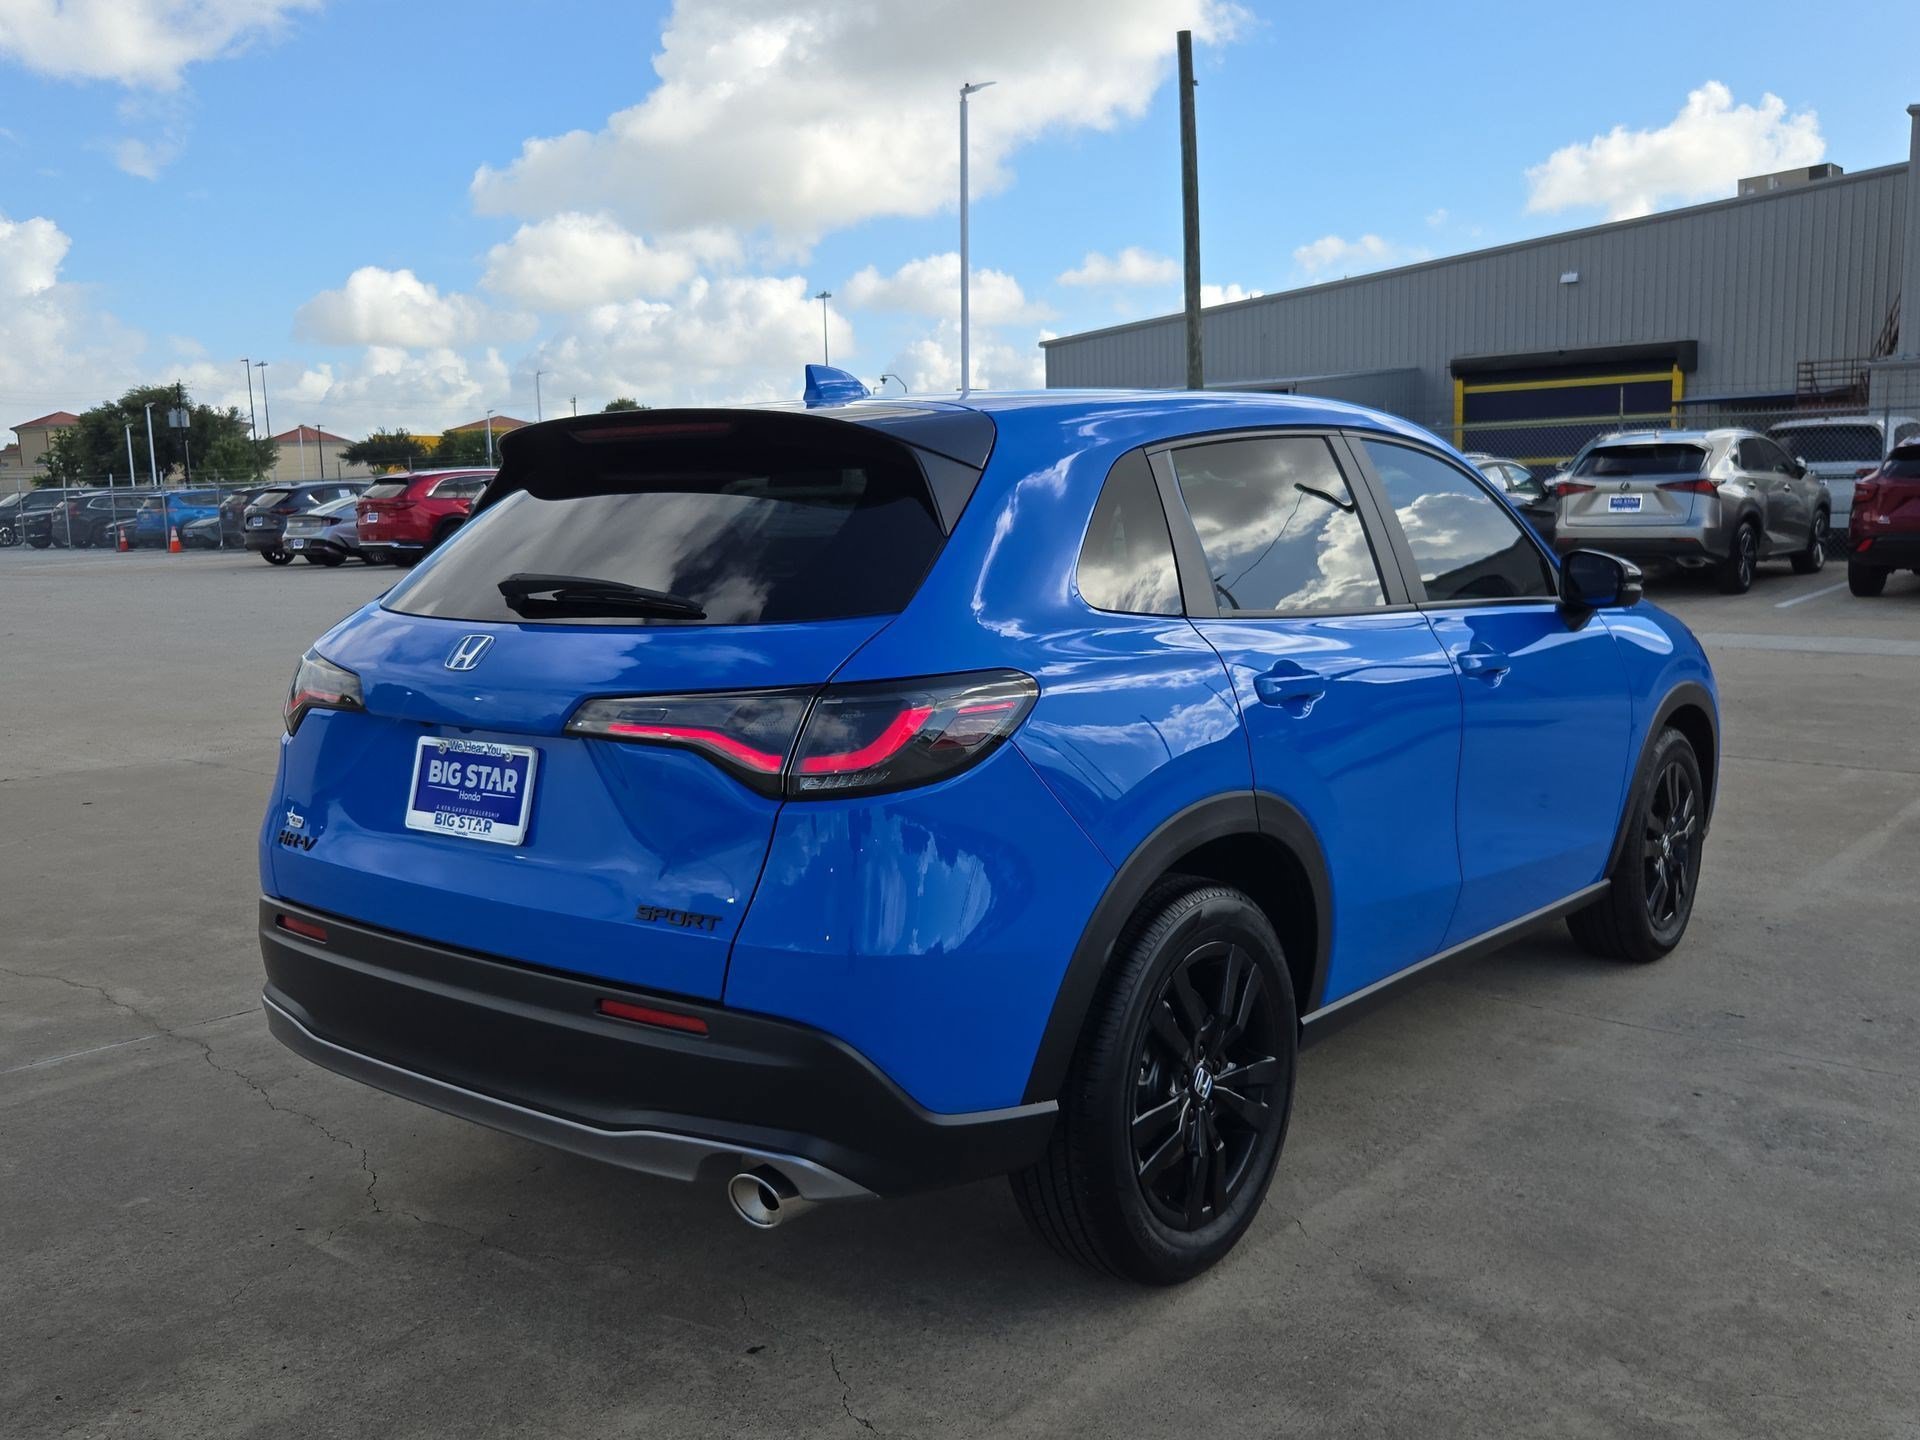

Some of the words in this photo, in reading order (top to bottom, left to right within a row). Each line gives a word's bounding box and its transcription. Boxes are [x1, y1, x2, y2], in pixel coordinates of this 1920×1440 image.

[450, 740, 463, 752] We
[464, 741, 484, 754] Hear
[487, 744, 502, 756] You
[428, 760, 462, 786] BIG
[465, 764, 518, 794] STAR
[458, 791, 481, 802] Honda
[434, 812, 456, 827] BIG
[458, 815, 493, 833] STAR
[278, 829, 318, 851] HR-V
[635, 904, 723, 931] SPORT
